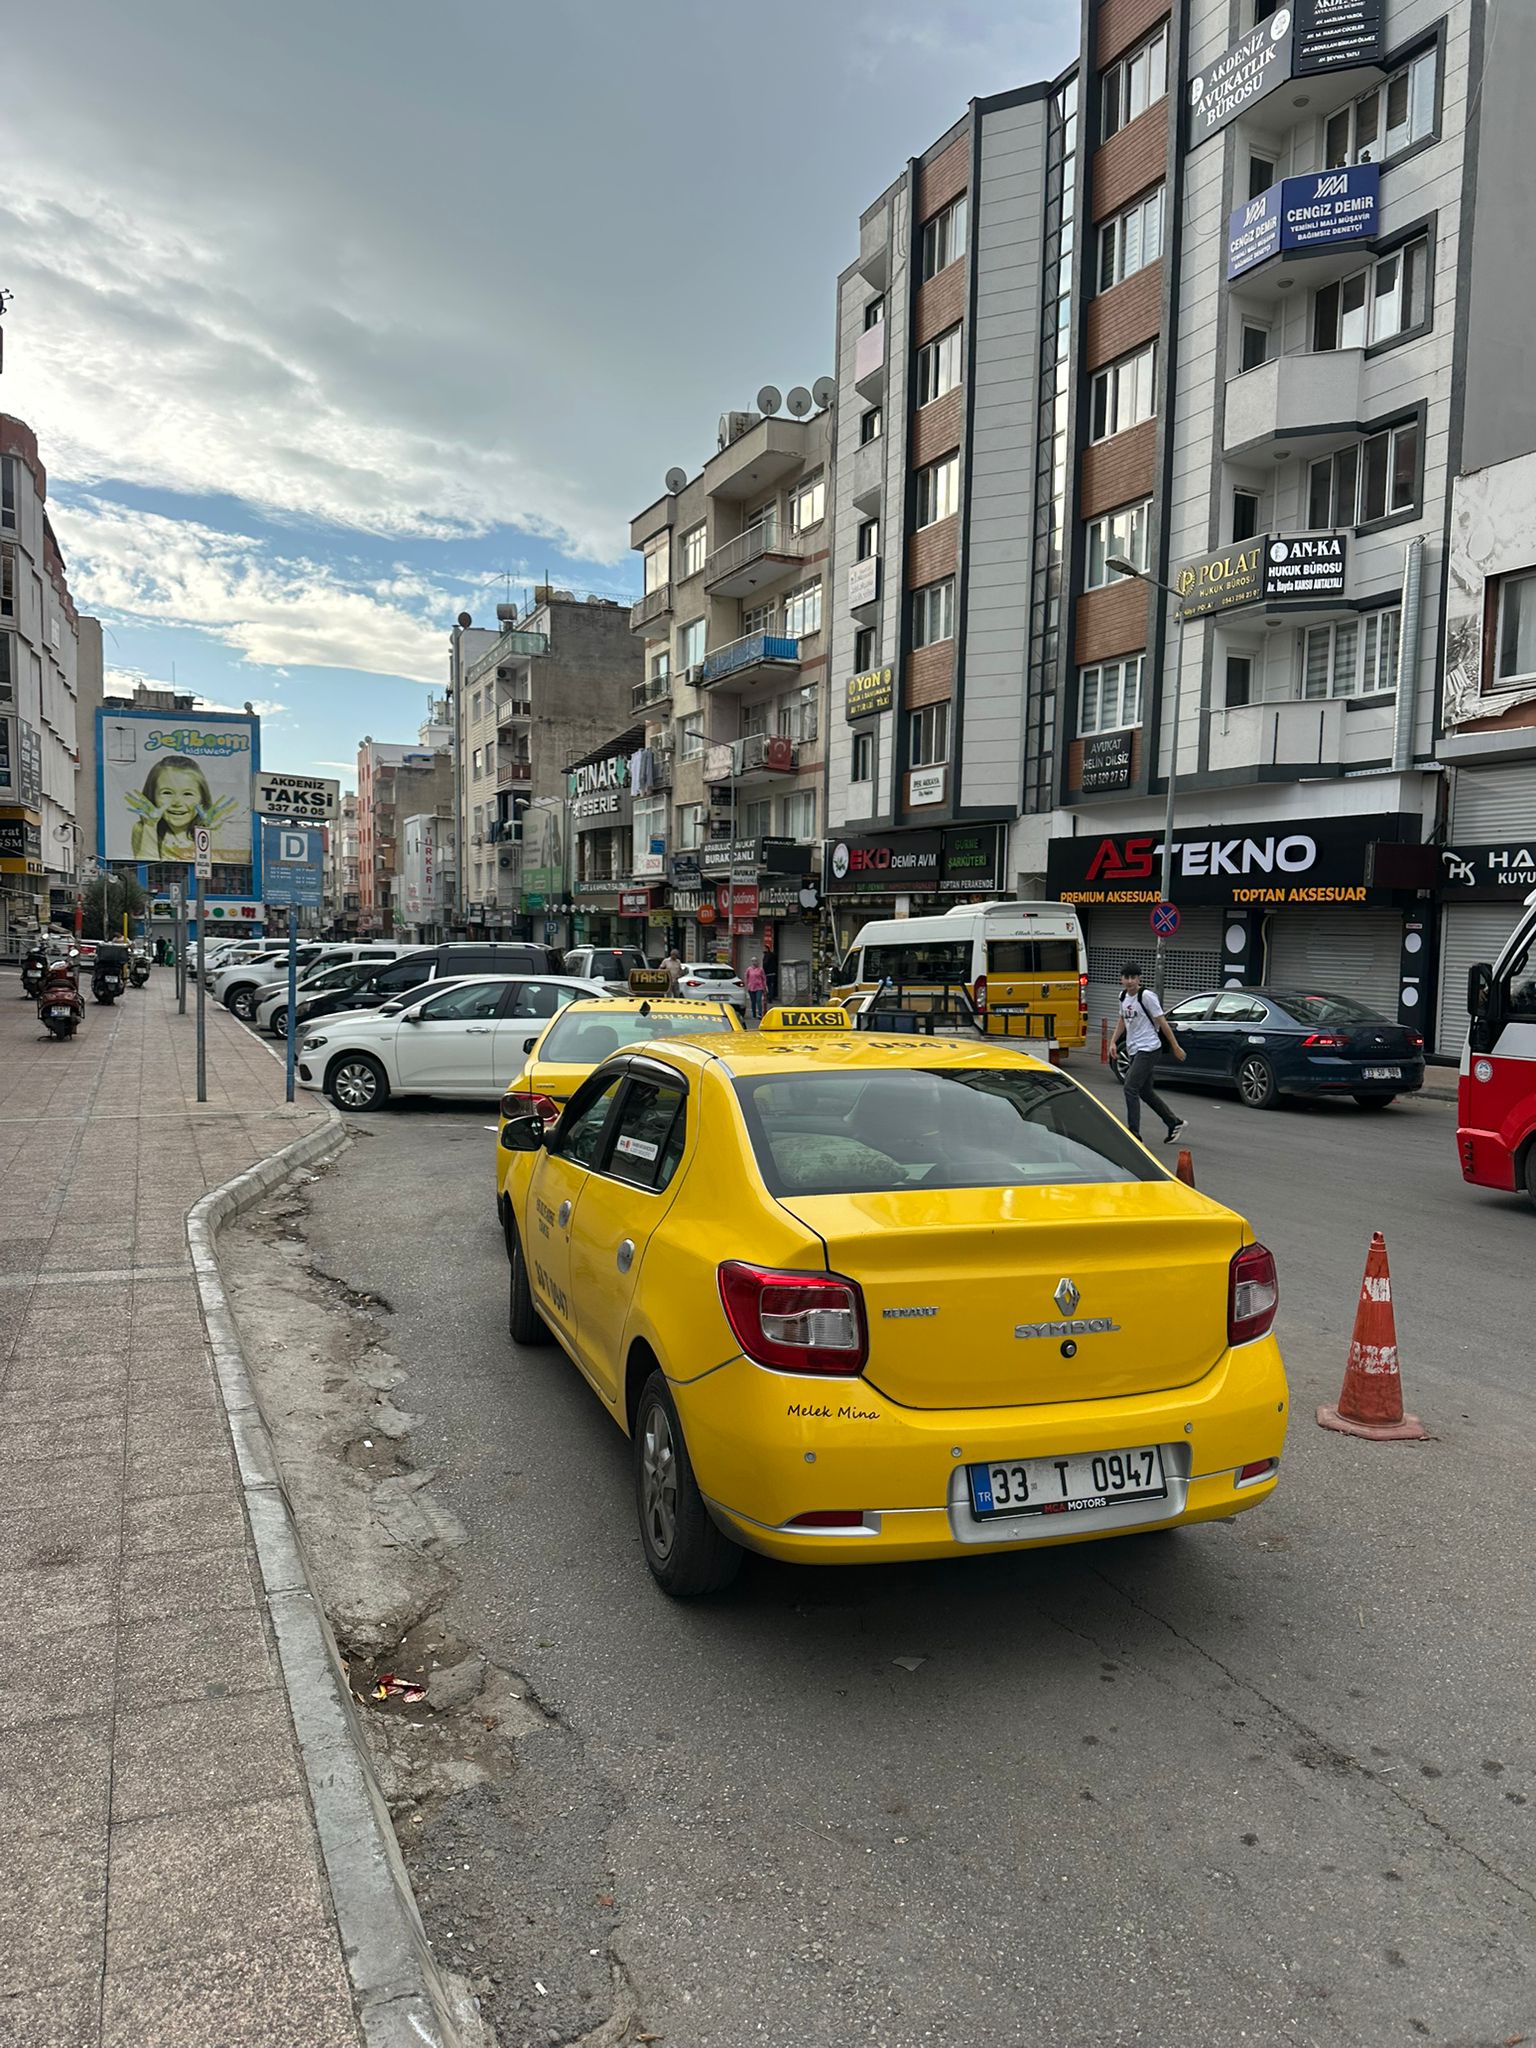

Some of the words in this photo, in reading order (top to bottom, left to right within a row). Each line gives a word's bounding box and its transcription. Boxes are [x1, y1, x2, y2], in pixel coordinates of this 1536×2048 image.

[1209, 31, 1264, 87] AKDENİZ
[1196, 43, 1277, 117] AVUKATLIK
[1206, 71, 1264, 127] BÜROSU
[1290, 220, 1319, 233] YEMİNLİ
[1320, 218, 1337, 228] MALİ
[1339, 212, 1370, 225] MÜŞAVİR
[1297, 228, 1331, 241] BAĞIMSIZ
[1332, 223, 1363, 235] DENETÇİ
[1289, 539, 1342, 559] AN-KA
[1198, 549, 1260, 586] POLAT
[1268, 565, 1302, 578] HUKUK
[1303, 561, 1342, 575] BÜROSU
[1199, 585, 1224, 598] HUKUK
[1225, 575, 1256, 590] BÜROSU
[145, 729, 250, 751] Jeliboom
[1090, 739, 1122, 754] AVUKAT
[270, 777, 325, 791] AKDENİZ
[268, 803, 290, 814] 337
[293, 806, 308, 815] 40
[310, 808, 325, 817] 05
[286, 835, 305, 858] D
[705, 853, 730, 864] BURAK
[850, 848, 890, 871] EKO
[891, 855, 916, 868] DEMİR
[917, 854, 936, 867] AVM
[960, 878, 994, 889] PERAKENDE
[1060, 890, 1105, 904] PREMIUM
[1106, 890, 1162, 904] AKSESUAR
[1232, 888, 1286, 902] TOPTAN
[1288, 886, 1367, 902] AKSESUAR
[882, 1306, 940, 1318] RENAULT
[1014, 1317, 1121, 1339] SYMBOL
[787, 1404, 833, 1417] Melek
[837, 1406, 880, 1420] Mina
[978, 1491, 992, 1503] TR
[992, 1467, 1029, 1504] 33
[1054, 1461, 1069, 1497] T
[1091, 1451, 1154, 1492] 0947
[1067, 1497, 1107, 1511] MOTORS
